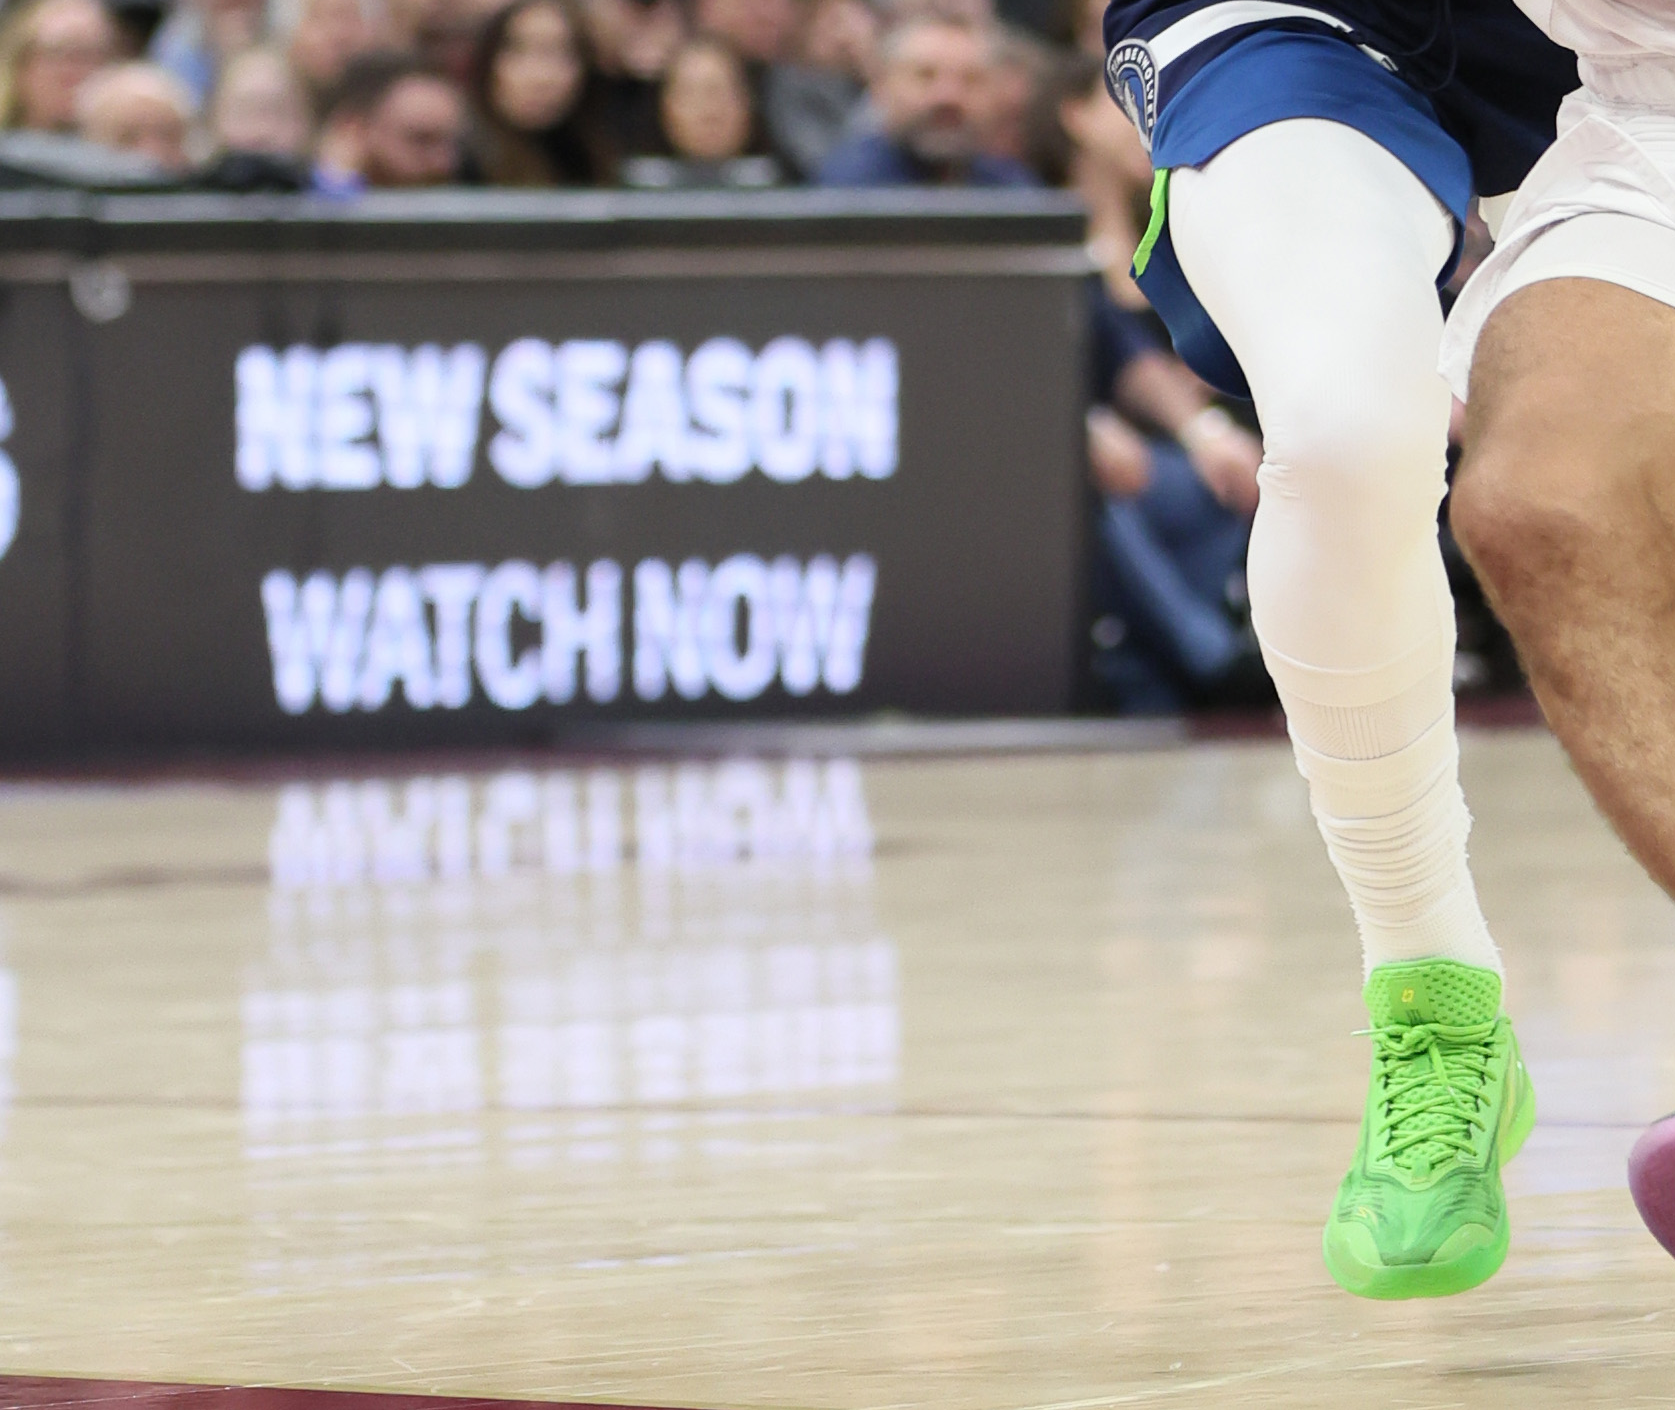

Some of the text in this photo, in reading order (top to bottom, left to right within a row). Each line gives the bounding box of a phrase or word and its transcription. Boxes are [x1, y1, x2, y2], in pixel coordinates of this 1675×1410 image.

[234, 335, 899, 491] NEW SEASON
[260, 552, 877, 713] WATCH NOW
